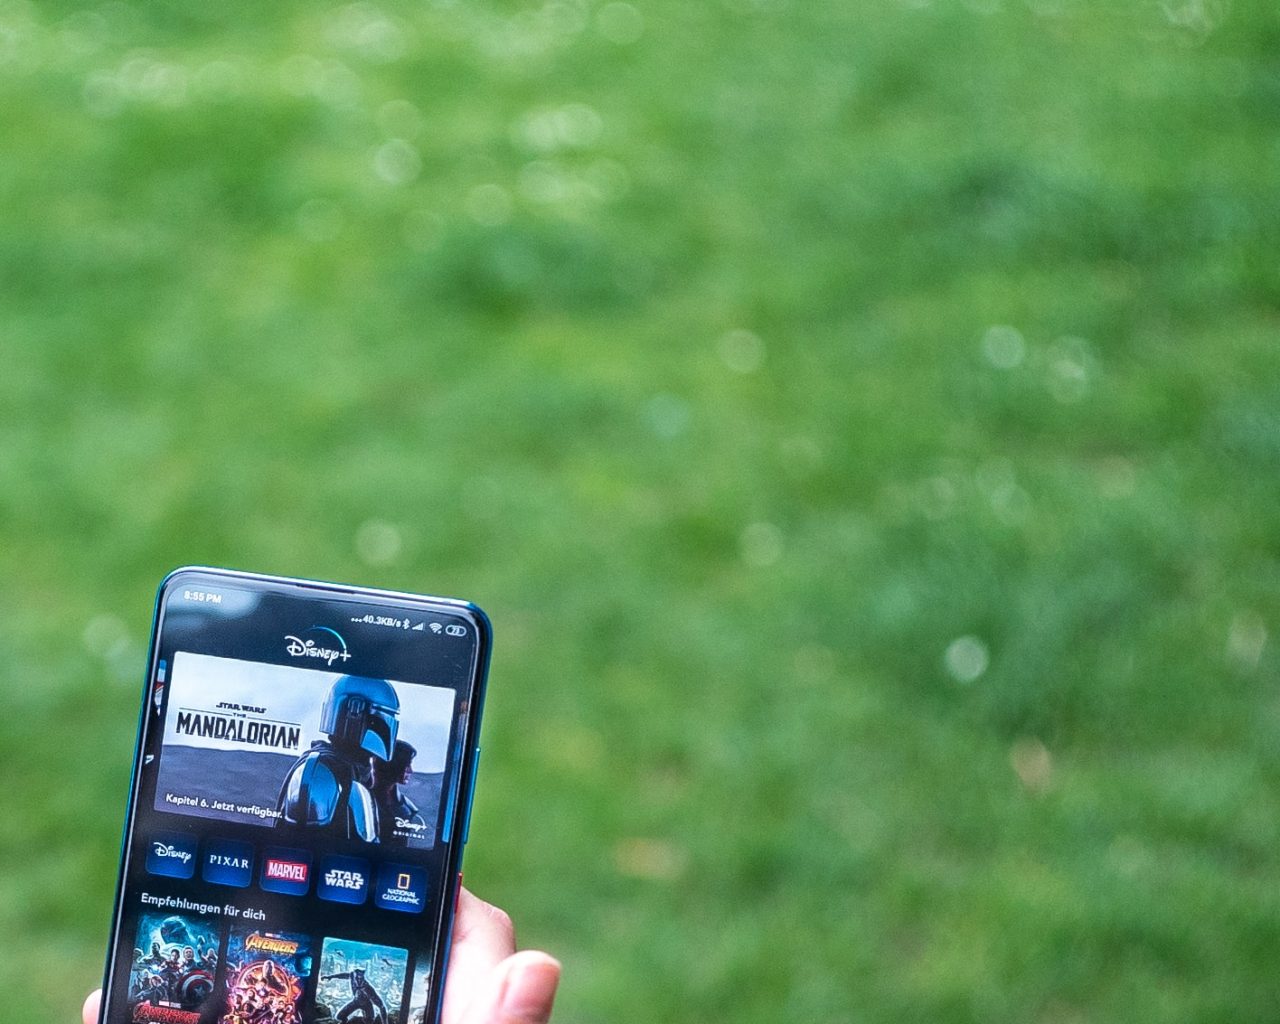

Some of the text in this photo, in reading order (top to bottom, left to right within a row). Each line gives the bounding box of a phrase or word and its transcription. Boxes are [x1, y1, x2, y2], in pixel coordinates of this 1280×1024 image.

[184, 590, 222, 604] 8:55 PM
[284, 635, 352, 666] Disney+
[216, 701, 267, 714] STAR WARS
[176, 711, 301, 750] MANDALORIAN
[166, 793, 199, 806] Kapitel
[211, 801, 234, 812] Jetzt
[236, 805, 283, 819] verfügbar.
[153, 842, 192, 864] Disney
[210, 854, 249, 869] PIXAR
[268, 861, 306, 881] MARVEL
[325, 869, 362, 882] STAR
[325, 876, 364, 890] WARS
[387, 887, 416, 898] NATIONAL
[141, 893, 266, 921] Empfehlungen für dich
